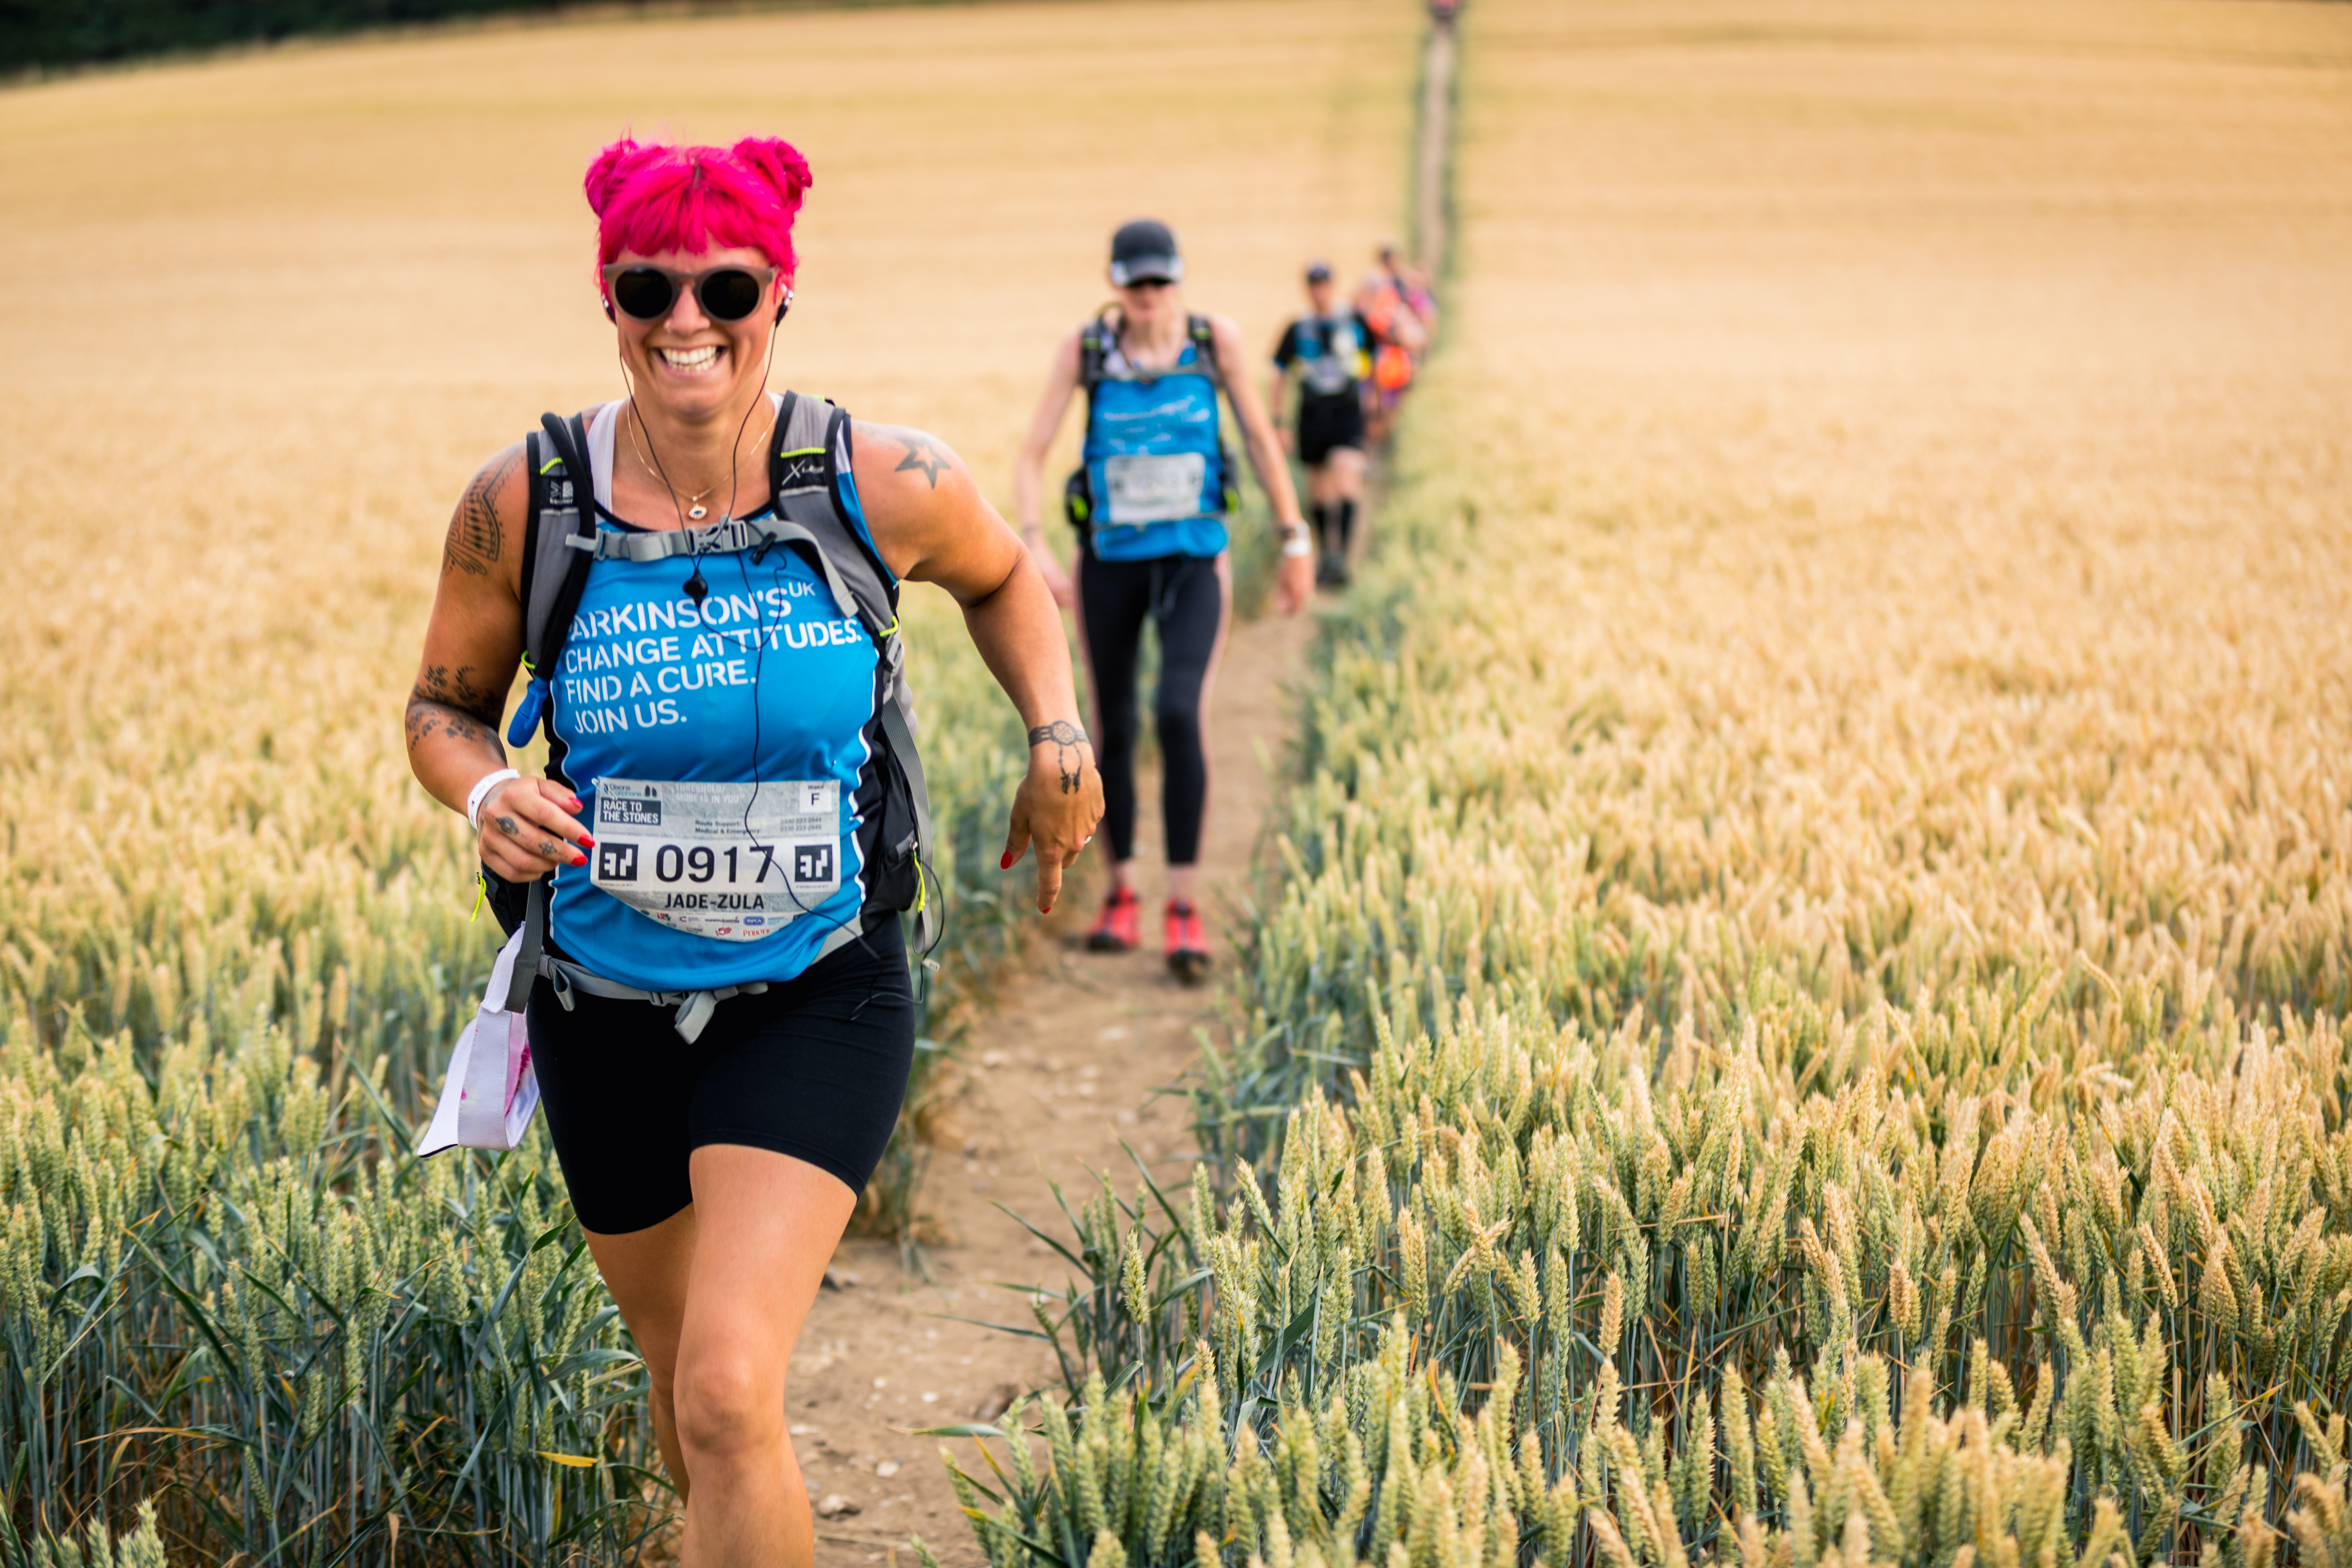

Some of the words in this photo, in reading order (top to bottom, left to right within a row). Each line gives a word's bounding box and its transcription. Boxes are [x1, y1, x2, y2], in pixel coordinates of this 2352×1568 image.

[568, 588, 792, 642] ARKINSON'S
[788, 582, 815, 597] UK
[566, 636, 681, 674] CHANGE
[691, 618, 862, 659] ATTITUDES.
[565, 675, 622, 703] FIND
[630, 671, 652, 698] A
[657, 659, 756, 693] CURE.
[574, 706, 628, 734] JOIN
[634, 698, 687, 728] US.
[603, 799, 628, 812] RACE
[630, 801, 642, 812] TO
[711, 795, 720, 803] IN
[812, 793, 820, 805] F
[603, 810, 620, 822] THE
[623, 811, 658, 824] STONES
[656, 845, 774, 883] 0917
[665, 893, 764, 909] JADE-ZULA
[743, 928, 770, 937] PERKIER
